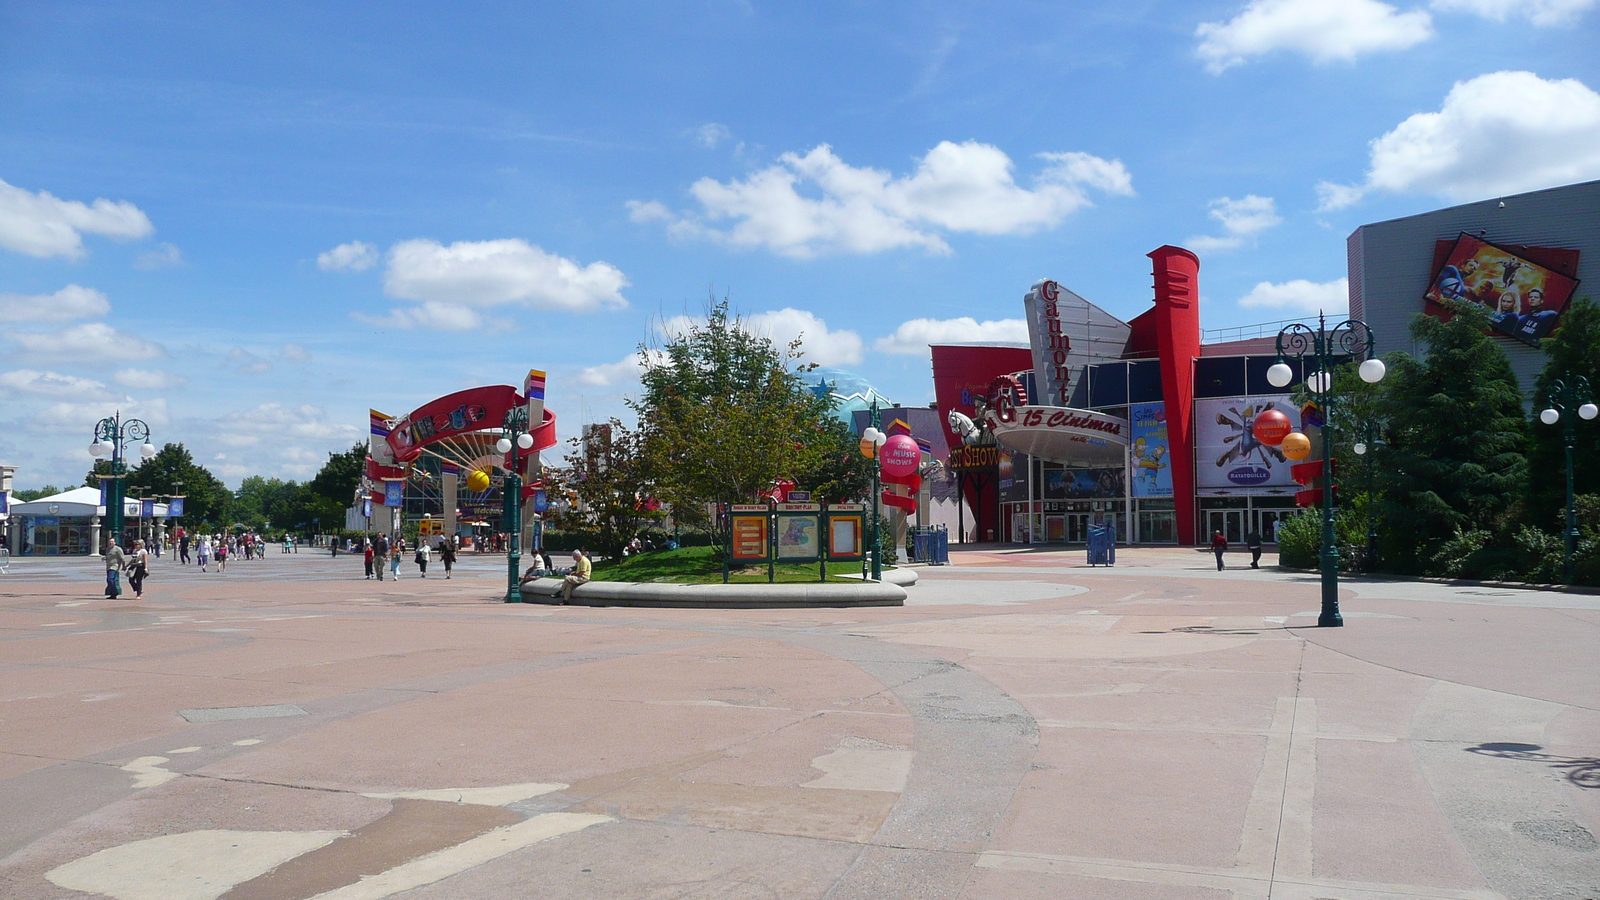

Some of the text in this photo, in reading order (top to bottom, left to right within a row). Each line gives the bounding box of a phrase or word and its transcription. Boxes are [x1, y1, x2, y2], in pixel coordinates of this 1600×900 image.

[1042, 280, 1071, 403] Gaumont
[1022, 409, 1044, 427] 15
[1047, 411, 1121, 435] Cinémas
[887, 457, 912, 466] SHOWS
[964, 445, 999, 468] SHOW
